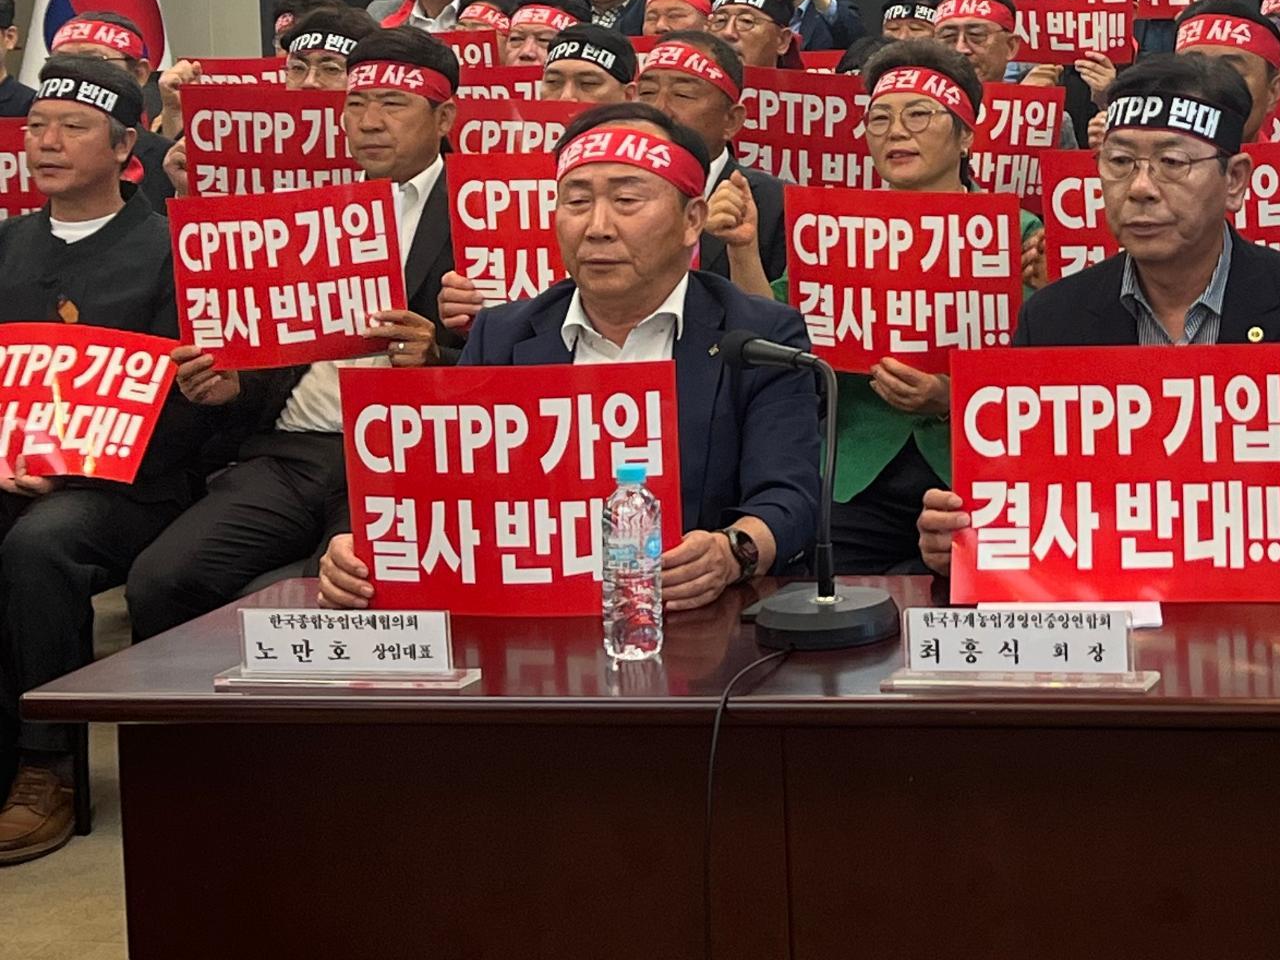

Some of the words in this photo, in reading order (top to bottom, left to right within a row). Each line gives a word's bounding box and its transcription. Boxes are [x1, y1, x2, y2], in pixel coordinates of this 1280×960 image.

[959, 0, 992, 16] 사수
[1015, 10, 1040, 48] 사
[1046, 10, 1125, 52] 반대!!
[1207, 20, 1251, 44] 사수
[94, 25, 131, 49] 사수
[581, 43, 616, 69] 반대
[380, 64, 425, 89] 사수
[683, 52, 723, 80] 사수
[922, 75, 960, 105] 사수
[76, 80, 119, 113] 반대
[741, 88, 847, 138] CPTPP
[1105, 96, 1163, 130] PTPP
[1168, 97, 1222, 139] 반대
[190, 110, 295, 154] CPTPP
[301, 108, 351, 158] 가
[990, 100, 1056, 147] 가입
[615, 134, 672, 168] 사수
[457, 179, 558, 231] CPTP
[178, 219, 289, 272] CPTPP
[295, 200, 389, 267] 가입
[793, 213, 913, 270] CPTPP
[920, 214, 1010, 278] 가입
[186, 286, 260, 349] 결사
[269, 275, 393, 345] 반대!!
[800, 281, 877, 351] 결사
[886, 290, 1010, 353] 반대!!
[0, 344, 76, 388] TPP
[73, 344, 171, 405] 가입
[23, 401, 144, 459] 반대!!
[354, 404, 529, 474] CPTPP
[539, 390, 663, 480] 가입
[964, 385, 1152, 457] CPTPP
[365, 496, 481, 585] 결사
[495, 498, 604, 584] 반대
[971, 481, 1099, 570] 결사
[372, 643, 434, 661] 상임대표
